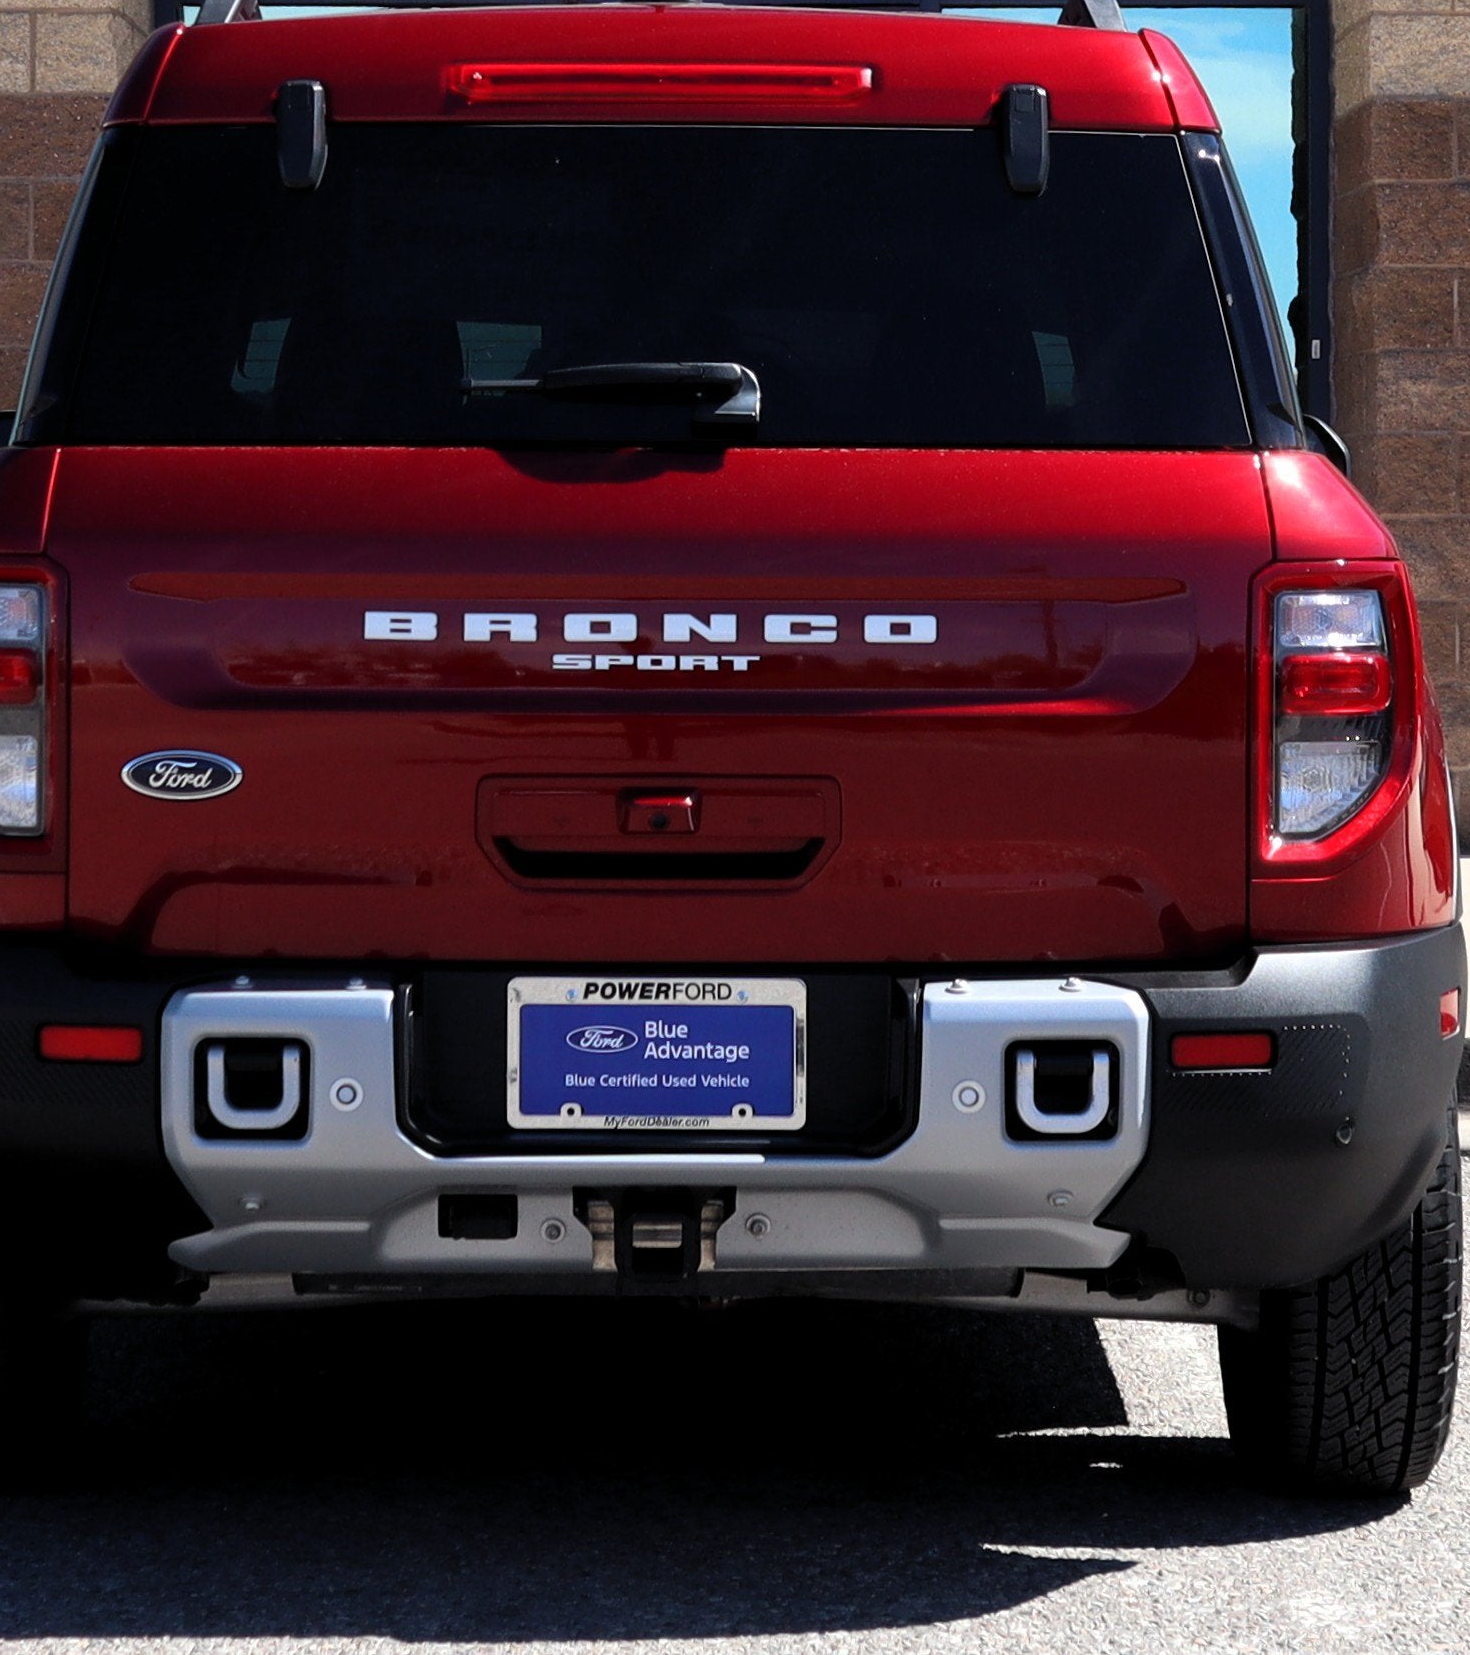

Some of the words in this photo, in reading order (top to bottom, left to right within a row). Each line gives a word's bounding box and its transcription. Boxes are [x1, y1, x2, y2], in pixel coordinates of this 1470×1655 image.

[363, 610, 939, 644] BRONCO
[552, 653, 761, 671] SPORT
[147, 760, 214, 792] Ford
[579, 1029, 625, 1049] Ford
[644, 1021, 688, 1039] Blue
[643, 1042, 750, 1063] Advantage
[565, 1074, 596, 1088] Blue
[599, 1074, 658, 1088] Certified
[662, 1074, 697, 1088] Used
[701, 1074, 750, 1088] Vehicle
[603, 1116, 710, 1129] MyFordDealer.com
